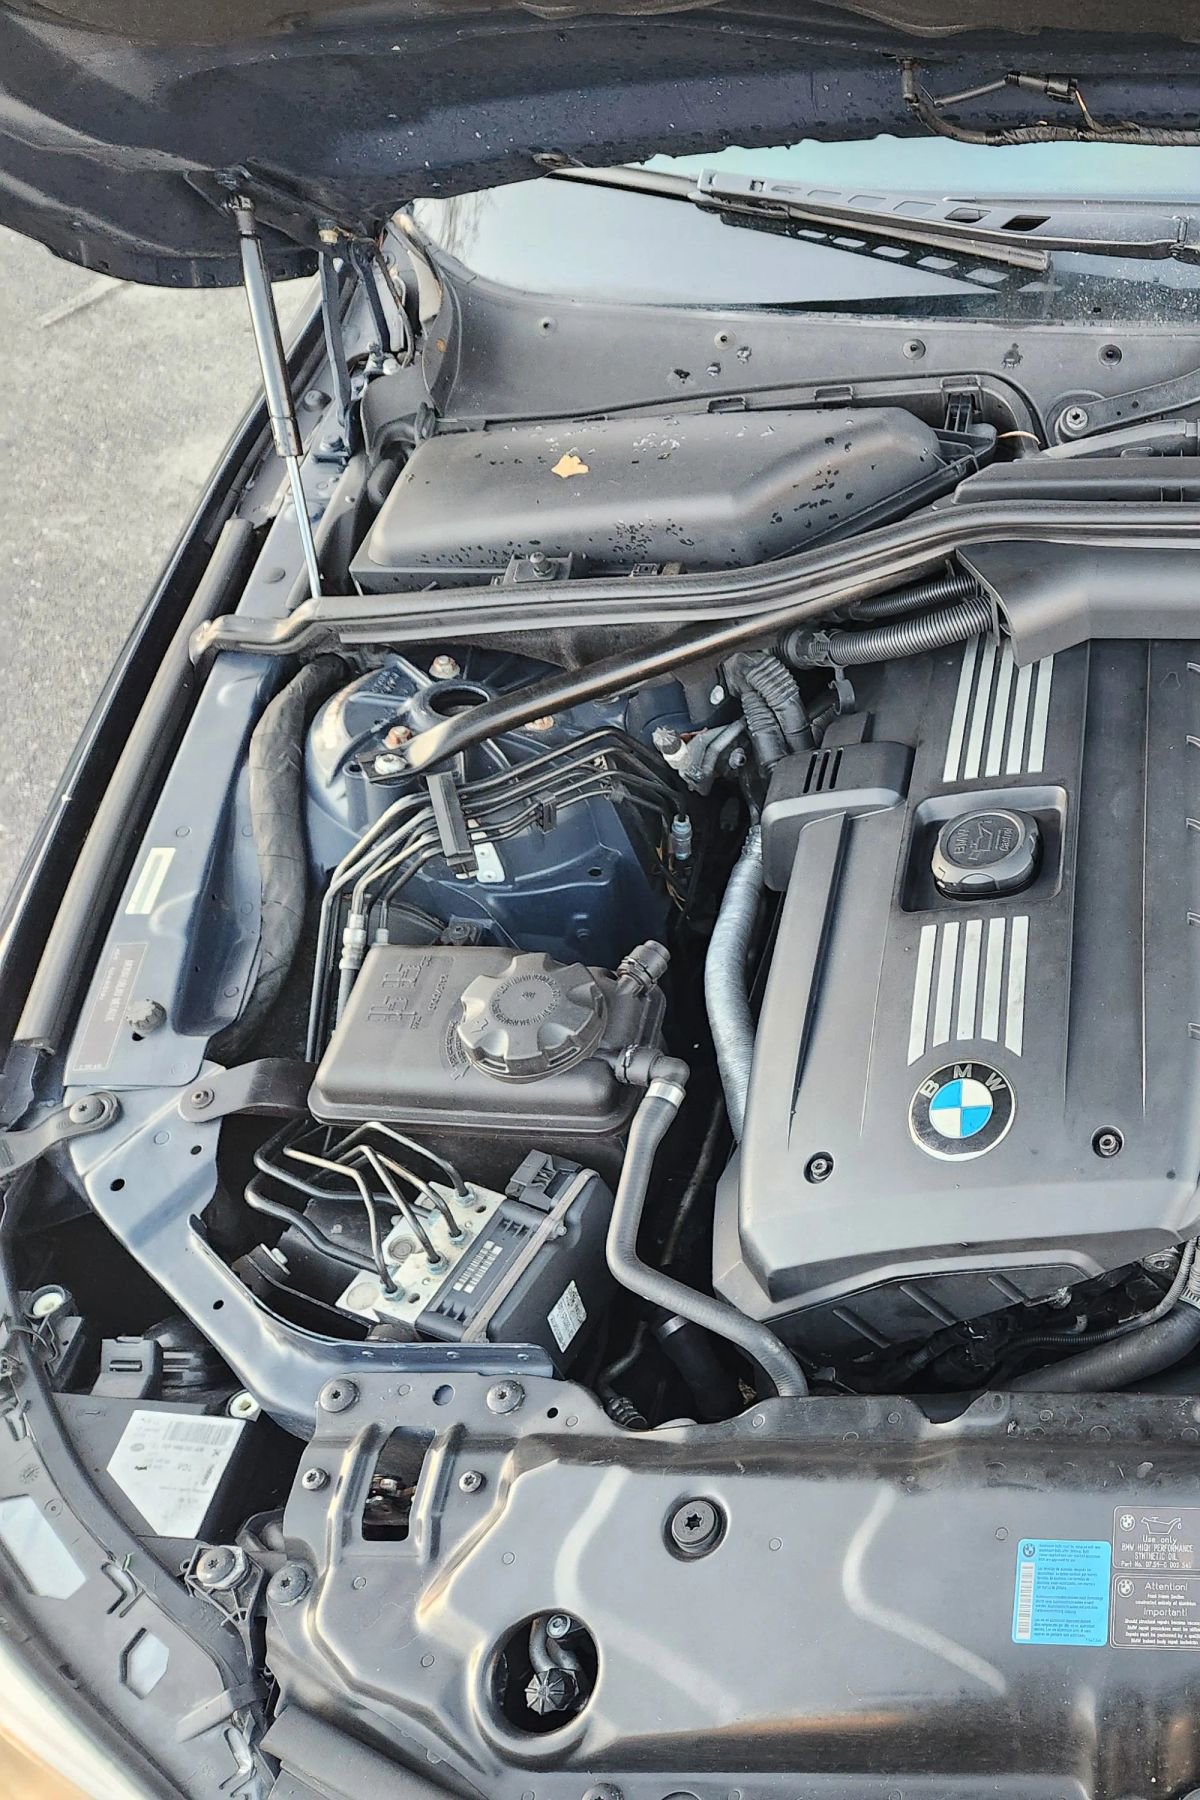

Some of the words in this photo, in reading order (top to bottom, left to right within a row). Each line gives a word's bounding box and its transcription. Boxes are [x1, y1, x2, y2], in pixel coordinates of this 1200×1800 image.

[954, 829, 970, 854] BMW
[919, 1063, 1007, 1099] BMW
[1142, 1534, 1156, 1543] Use
[1160, 1535, 1177, 1546] only
[1121, 1542, 1134, 1552] BMW
[1153, 1543, 1194, 1553] PERFORMANCE
[1134, 1552, 1166, 1561] SYNTHETIC
[1144, 1581, 1188, 1591] Attention!
[1143, 1607, 1188, 1617] Important!
